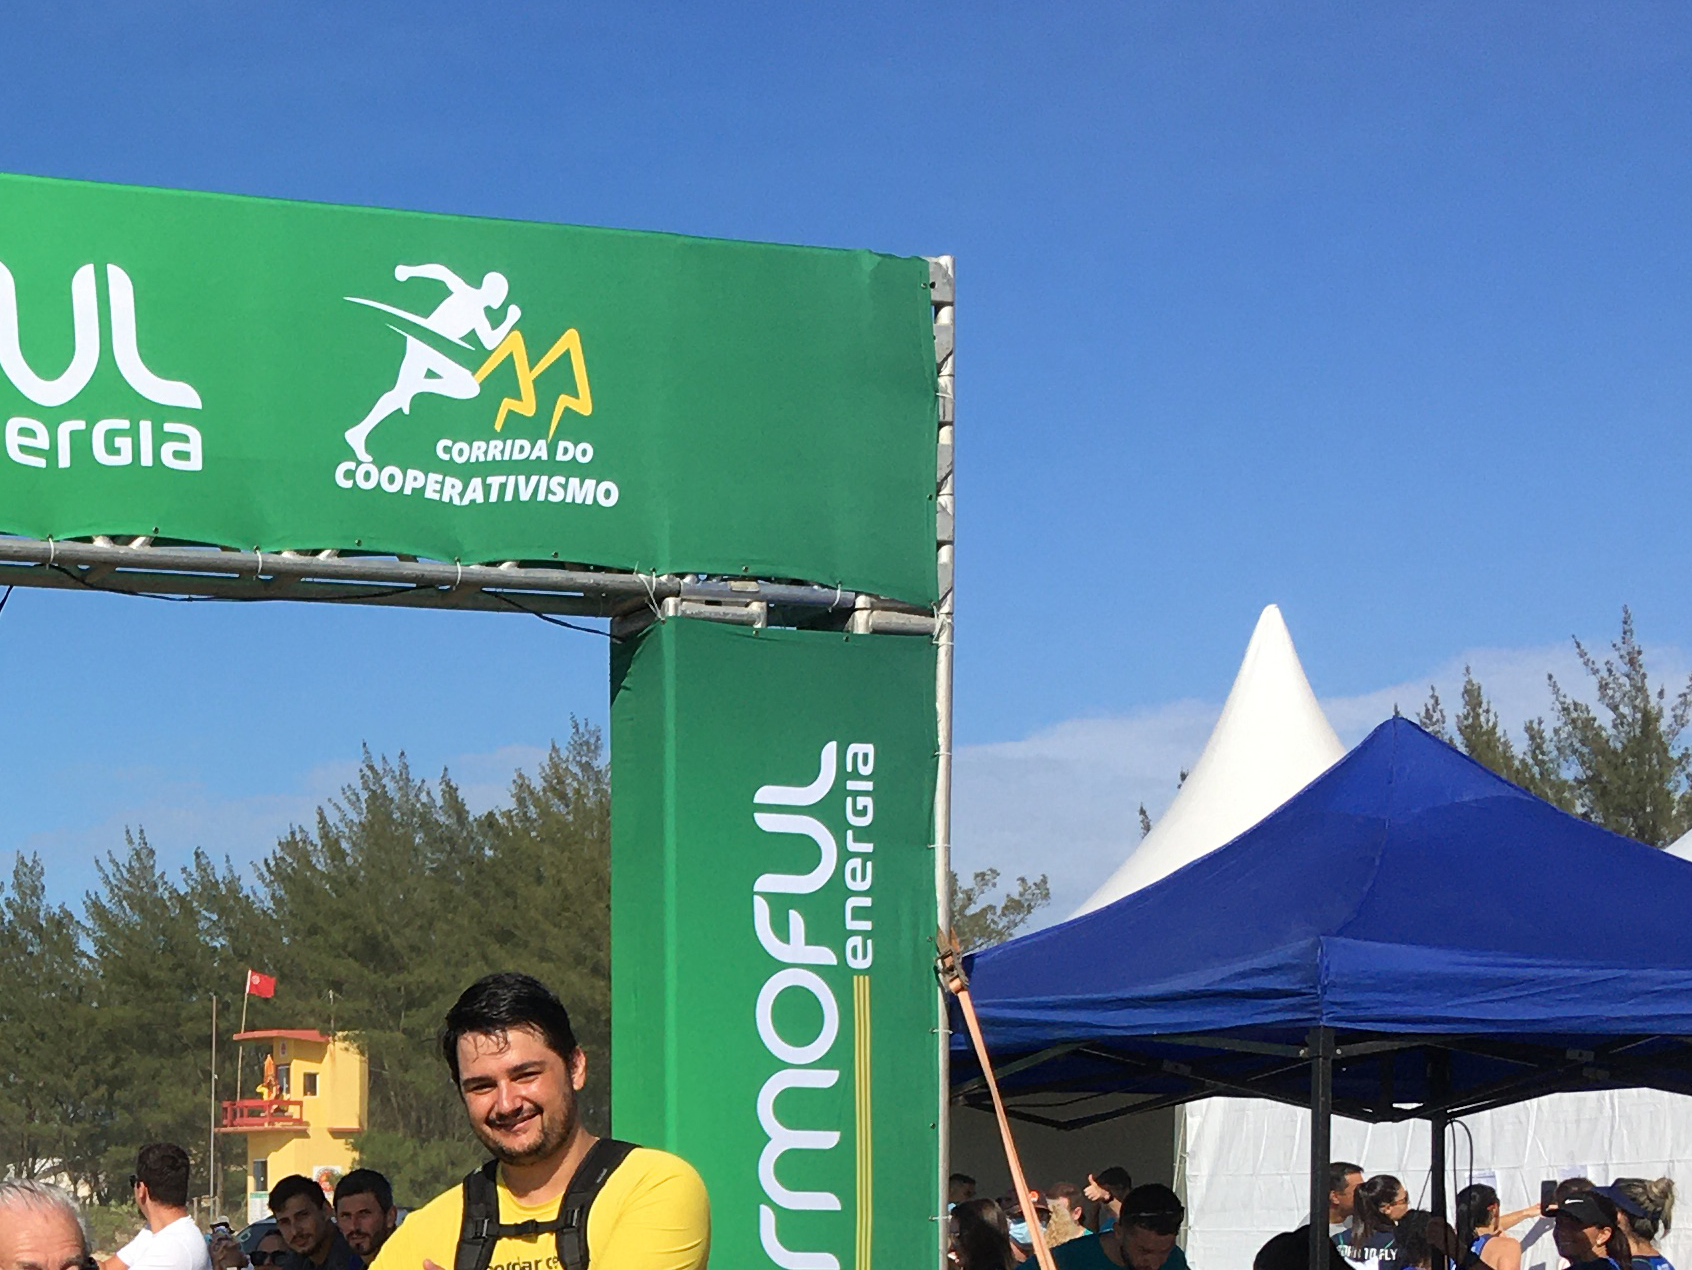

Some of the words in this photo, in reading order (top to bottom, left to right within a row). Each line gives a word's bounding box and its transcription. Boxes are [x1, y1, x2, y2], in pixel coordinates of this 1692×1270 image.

[435, 438, 548, 463] CORRIDA
[555, 440, 594, 463] DO
[334, 460, 619, 507] COOPERATIVISMO
[845, 742, 875, 971] energia
[1379, 1248, 1398, 1260] FLY
